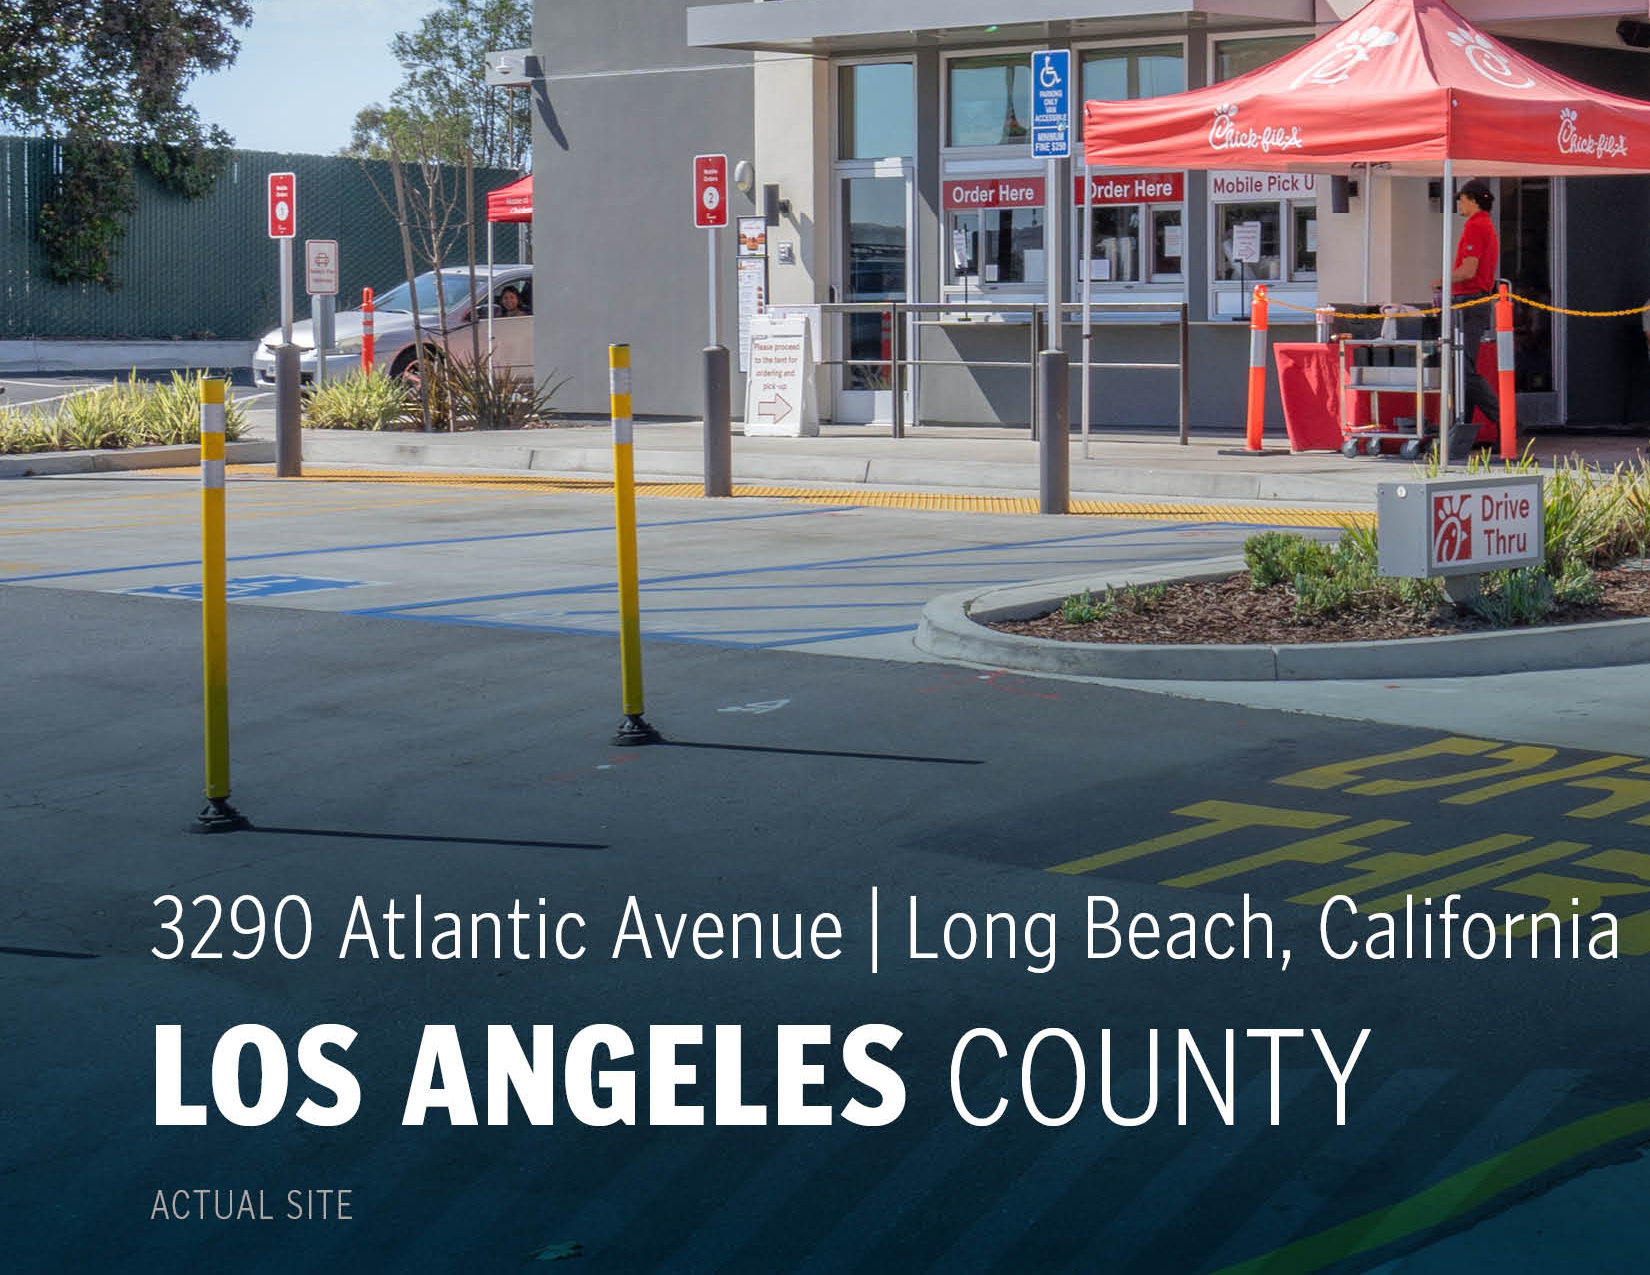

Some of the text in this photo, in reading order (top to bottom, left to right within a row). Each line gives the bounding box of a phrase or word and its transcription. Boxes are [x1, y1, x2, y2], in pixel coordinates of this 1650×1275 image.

[1044, 98, 1058, 106] ONLY
[1035, 142, 1050, 151] FINE
[1135, 179, 1174, 197] Here
[1213, 173, 1315, 194] Mobile Pick U
[952, 184, 1035, 203] Order Here
[1481, 492, 1530, 522] Drive
[1483, 529, 1527, 556] Thru
